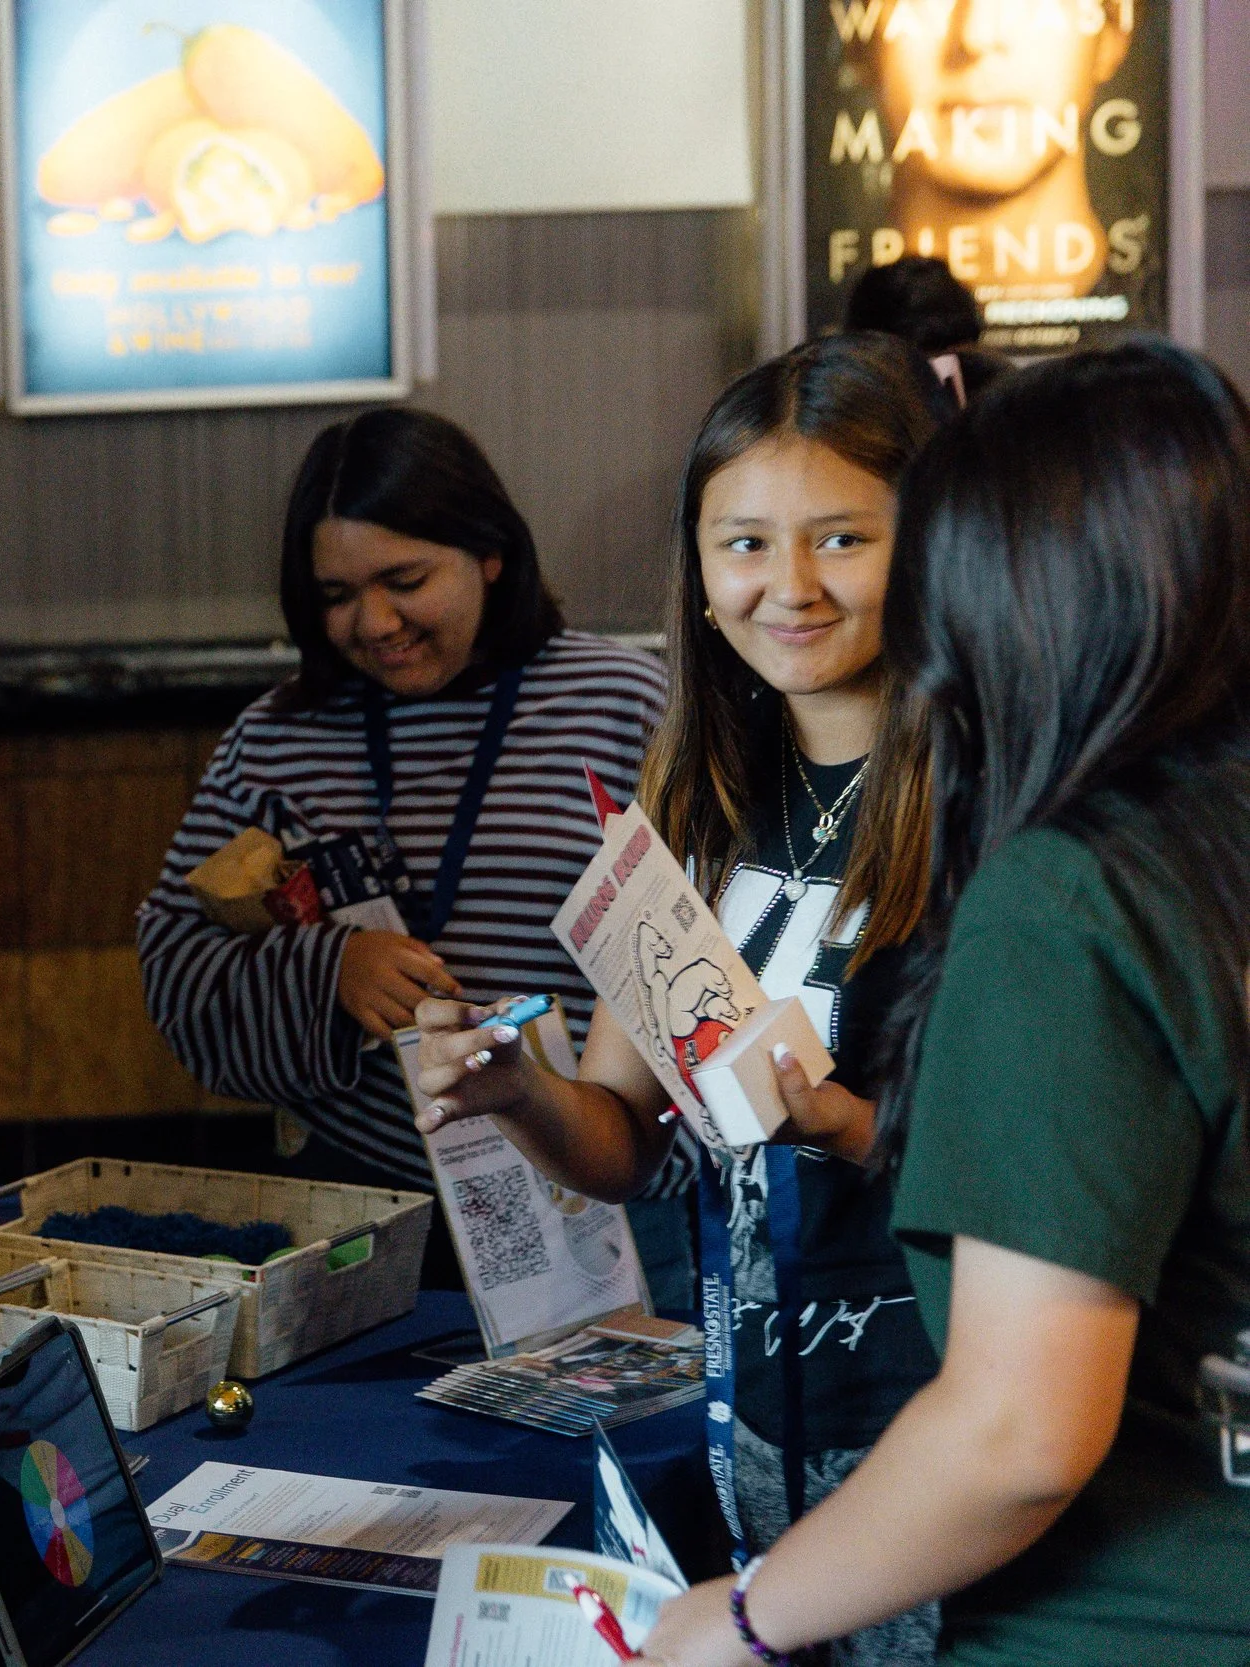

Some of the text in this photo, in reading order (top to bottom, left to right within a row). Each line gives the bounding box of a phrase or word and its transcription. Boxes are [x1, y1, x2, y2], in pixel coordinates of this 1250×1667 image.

[829, 98, 1142, 165] MAKING
[151, 1502, 188, 1524] Dual
[188, 1469, 256, 1515] Enrollment
